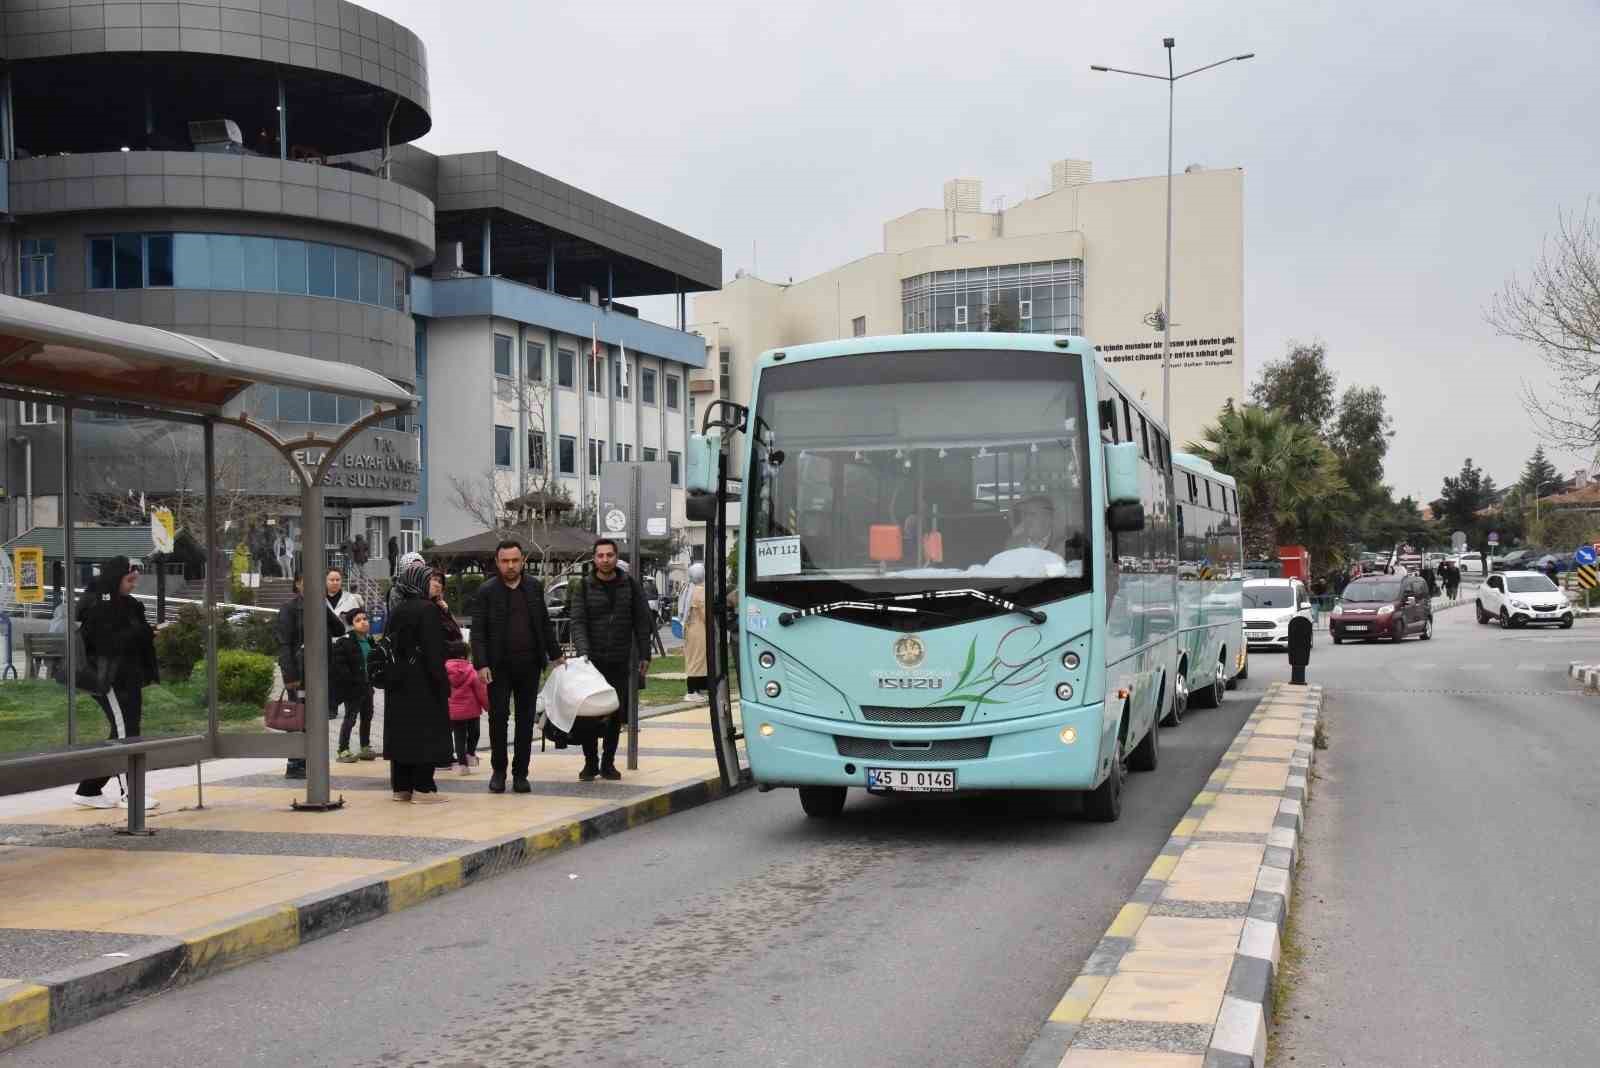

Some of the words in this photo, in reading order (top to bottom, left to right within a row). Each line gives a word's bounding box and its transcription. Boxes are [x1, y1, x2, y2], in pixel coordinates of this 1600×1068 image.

[758, 545, 777, 557] HAT
[781, 544, 798, 555] 112
[878, 678, 943, 689] ISUZU
[876, 771, 892, 784] 45
[900, 772, 908, 785] D
[917, 773, 952, 786] 0146
